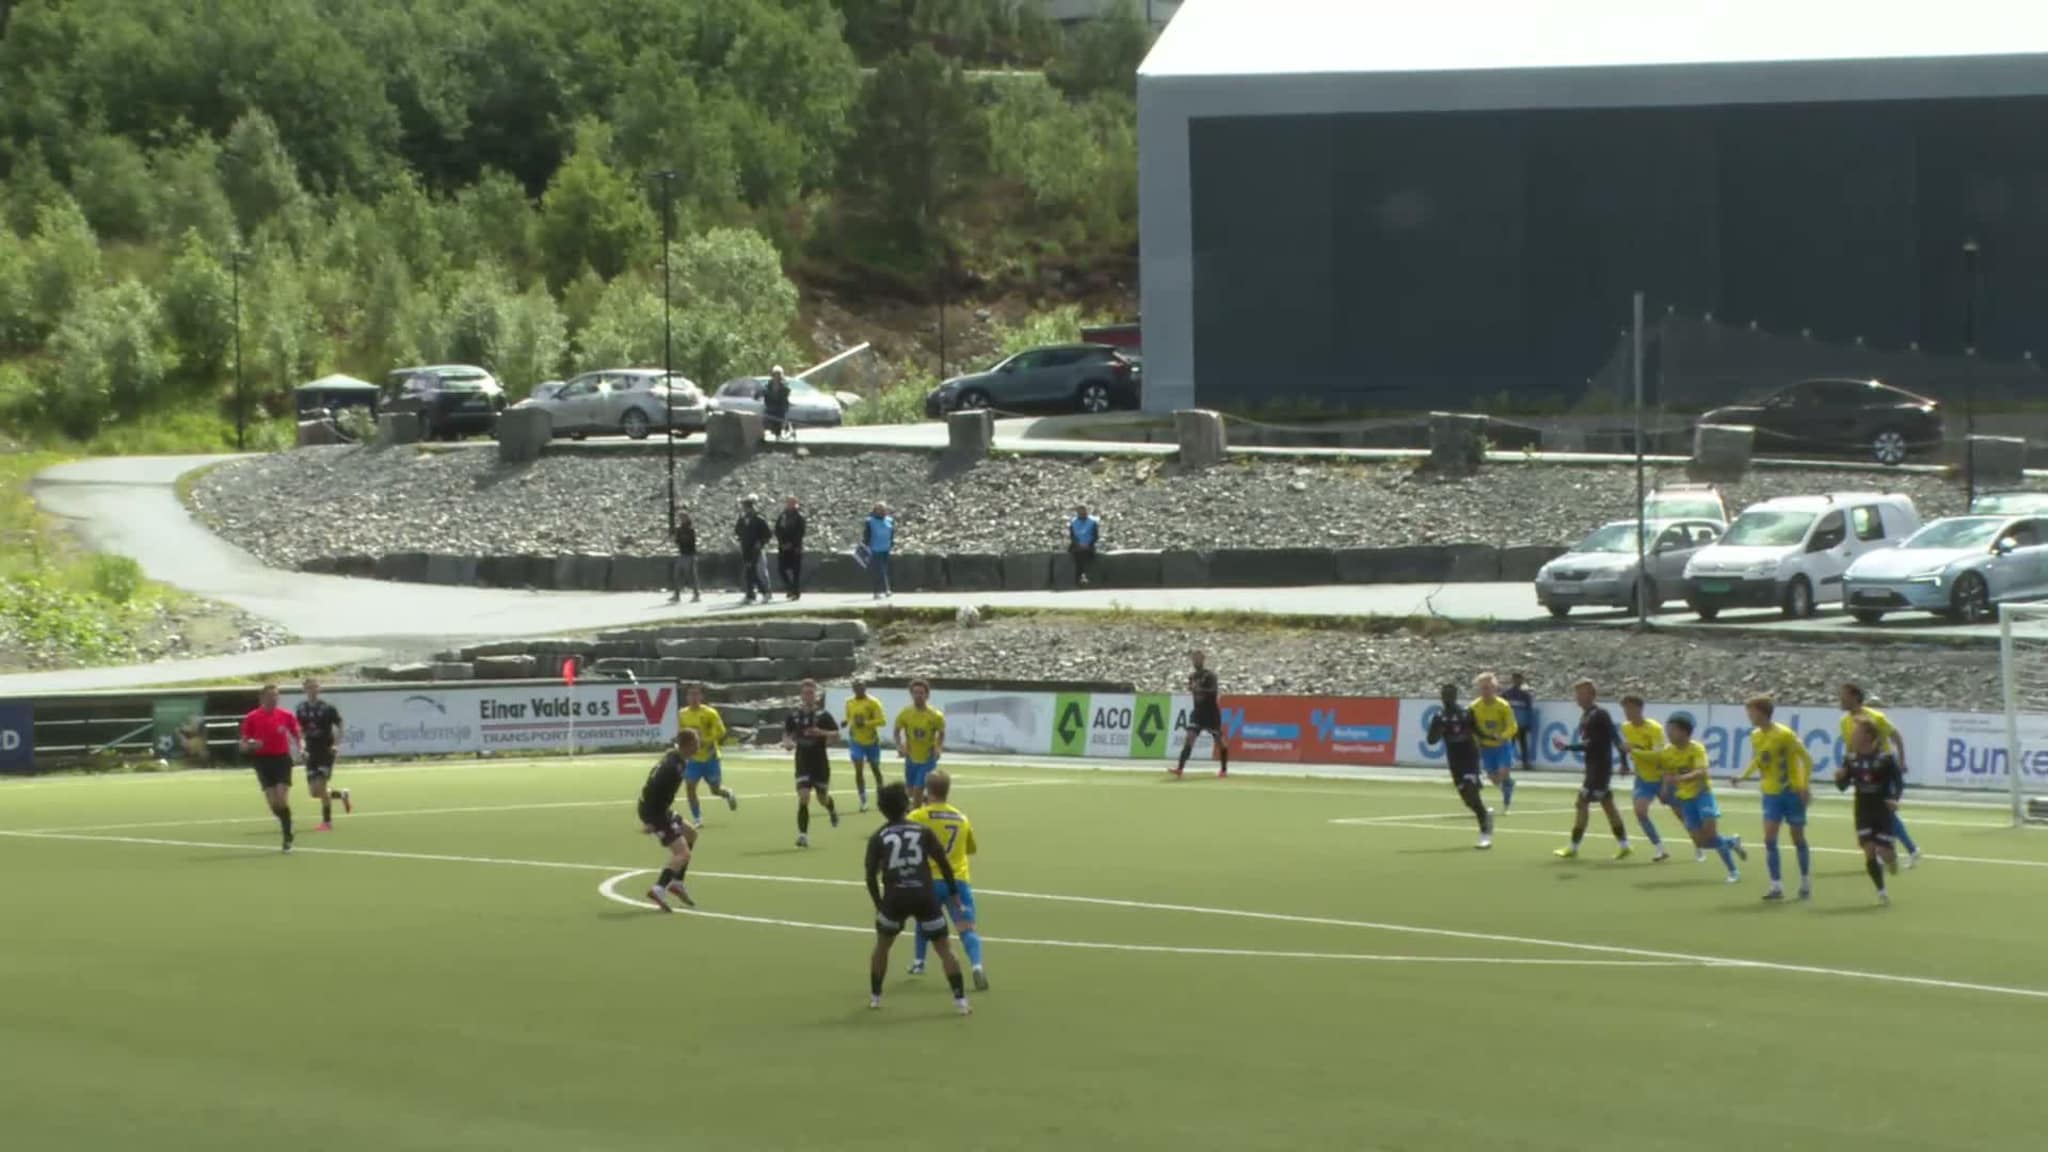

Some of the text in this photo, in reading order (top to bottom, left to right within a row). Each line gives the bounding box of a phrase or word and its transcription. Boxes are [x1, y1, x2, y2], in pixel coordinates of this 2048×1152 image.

[480, 700, 527, 719] Einar
[617, 688, 672, 725] EV
[1093, 708, 1131, 729] ACO
[0, 729, 21, 751] D
[883, 831, 923, 869] 23
[944, 824, 961, 854] 7
